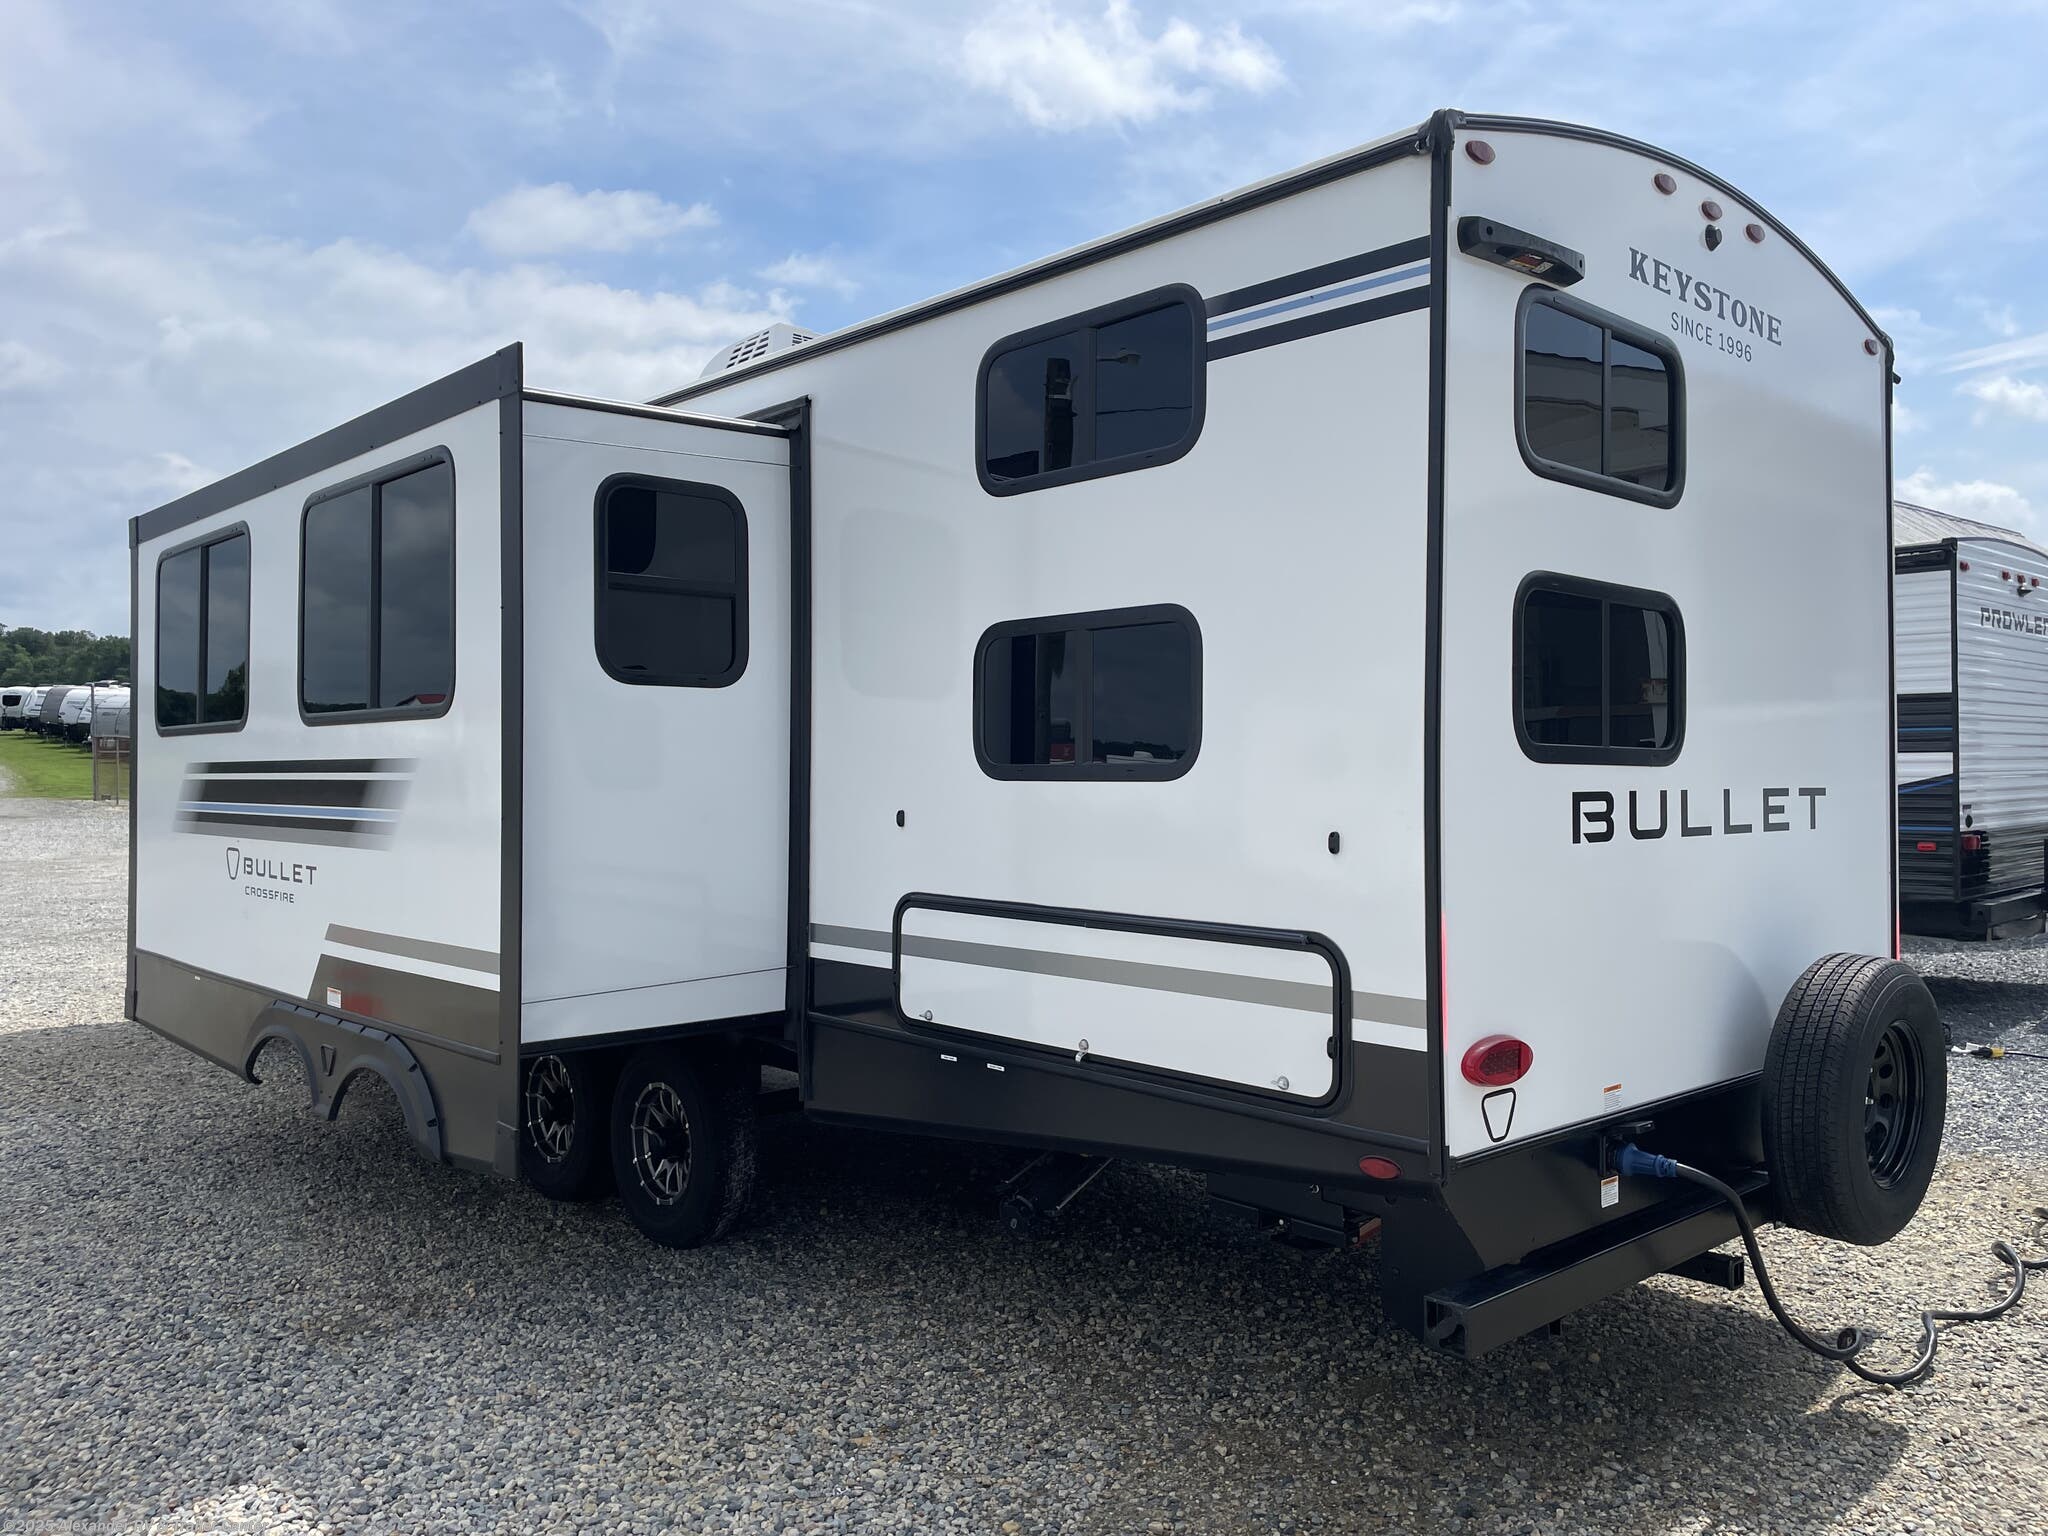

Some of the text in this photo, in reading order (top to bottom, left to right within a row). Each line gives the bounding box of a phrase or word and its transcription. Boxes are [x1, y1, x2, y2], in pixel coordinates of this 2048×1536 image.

[1628, 246, 1783, 347] KEYSTONE
[1670, 311, 1753, 363] SINCE 1996
[1571, 786, 1827, 844] BULLET
[243, 856, 318, 886] BULLET
[244, 885, 296, 904] CROSSFIRE
